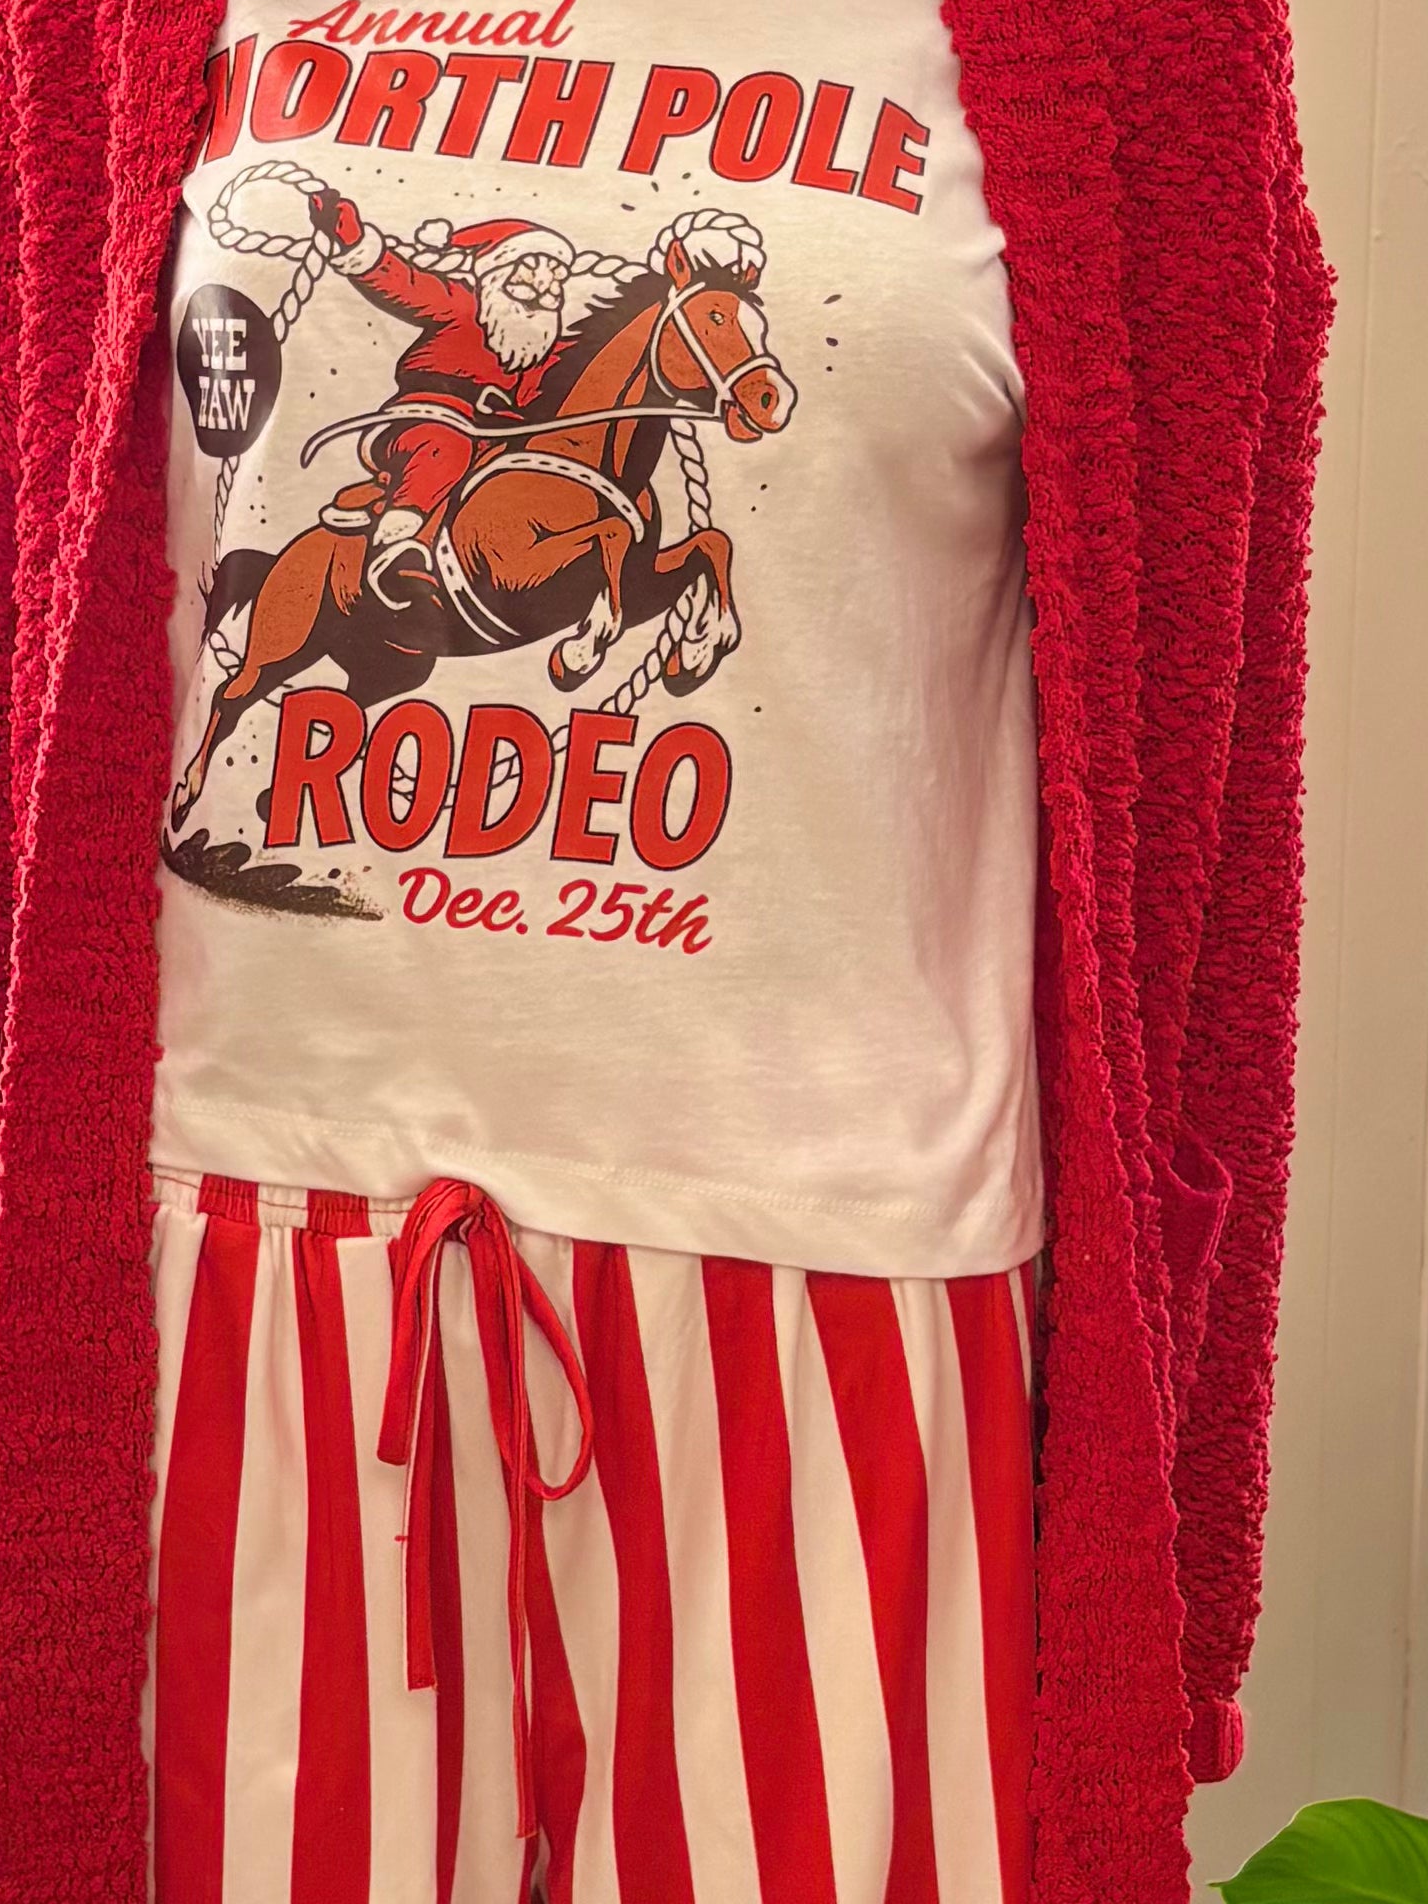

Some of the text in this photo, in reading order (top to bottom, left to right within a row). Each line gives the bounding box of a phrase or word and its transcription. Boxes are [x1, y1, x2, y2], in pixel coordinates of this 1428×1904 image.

[184, 32, 931, 216] NORTH POLE
[191, 317, 247, 372] YEE
[263, 686, 733, 871] RODEO
[398, 866, 713, 955] Dec. 25th
